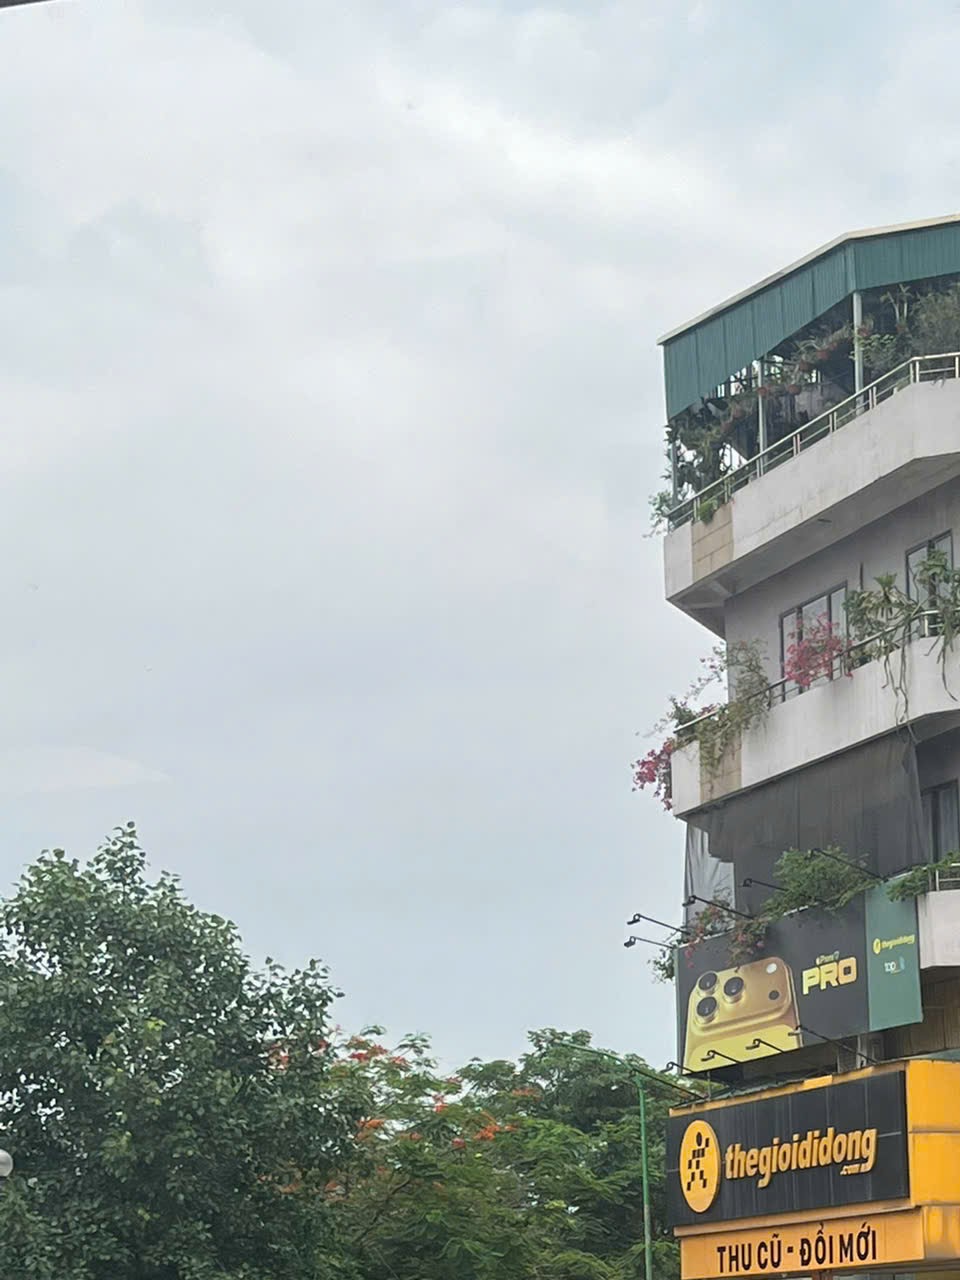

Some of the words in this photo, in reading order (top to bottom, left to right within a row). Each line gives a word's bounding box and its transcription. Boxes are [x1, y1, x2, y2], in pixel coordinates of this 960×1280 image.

[802, 956, 857, 995] PRO
[725, 1127, 878, 1188] thegioididong
[717, 1243, 752, 1273] THU
[757, 1233, 782, 1270] CŨ
[800, 1221, 834, 1267] ĐỔI
[839, 1222, 877, 1263] MỚI
